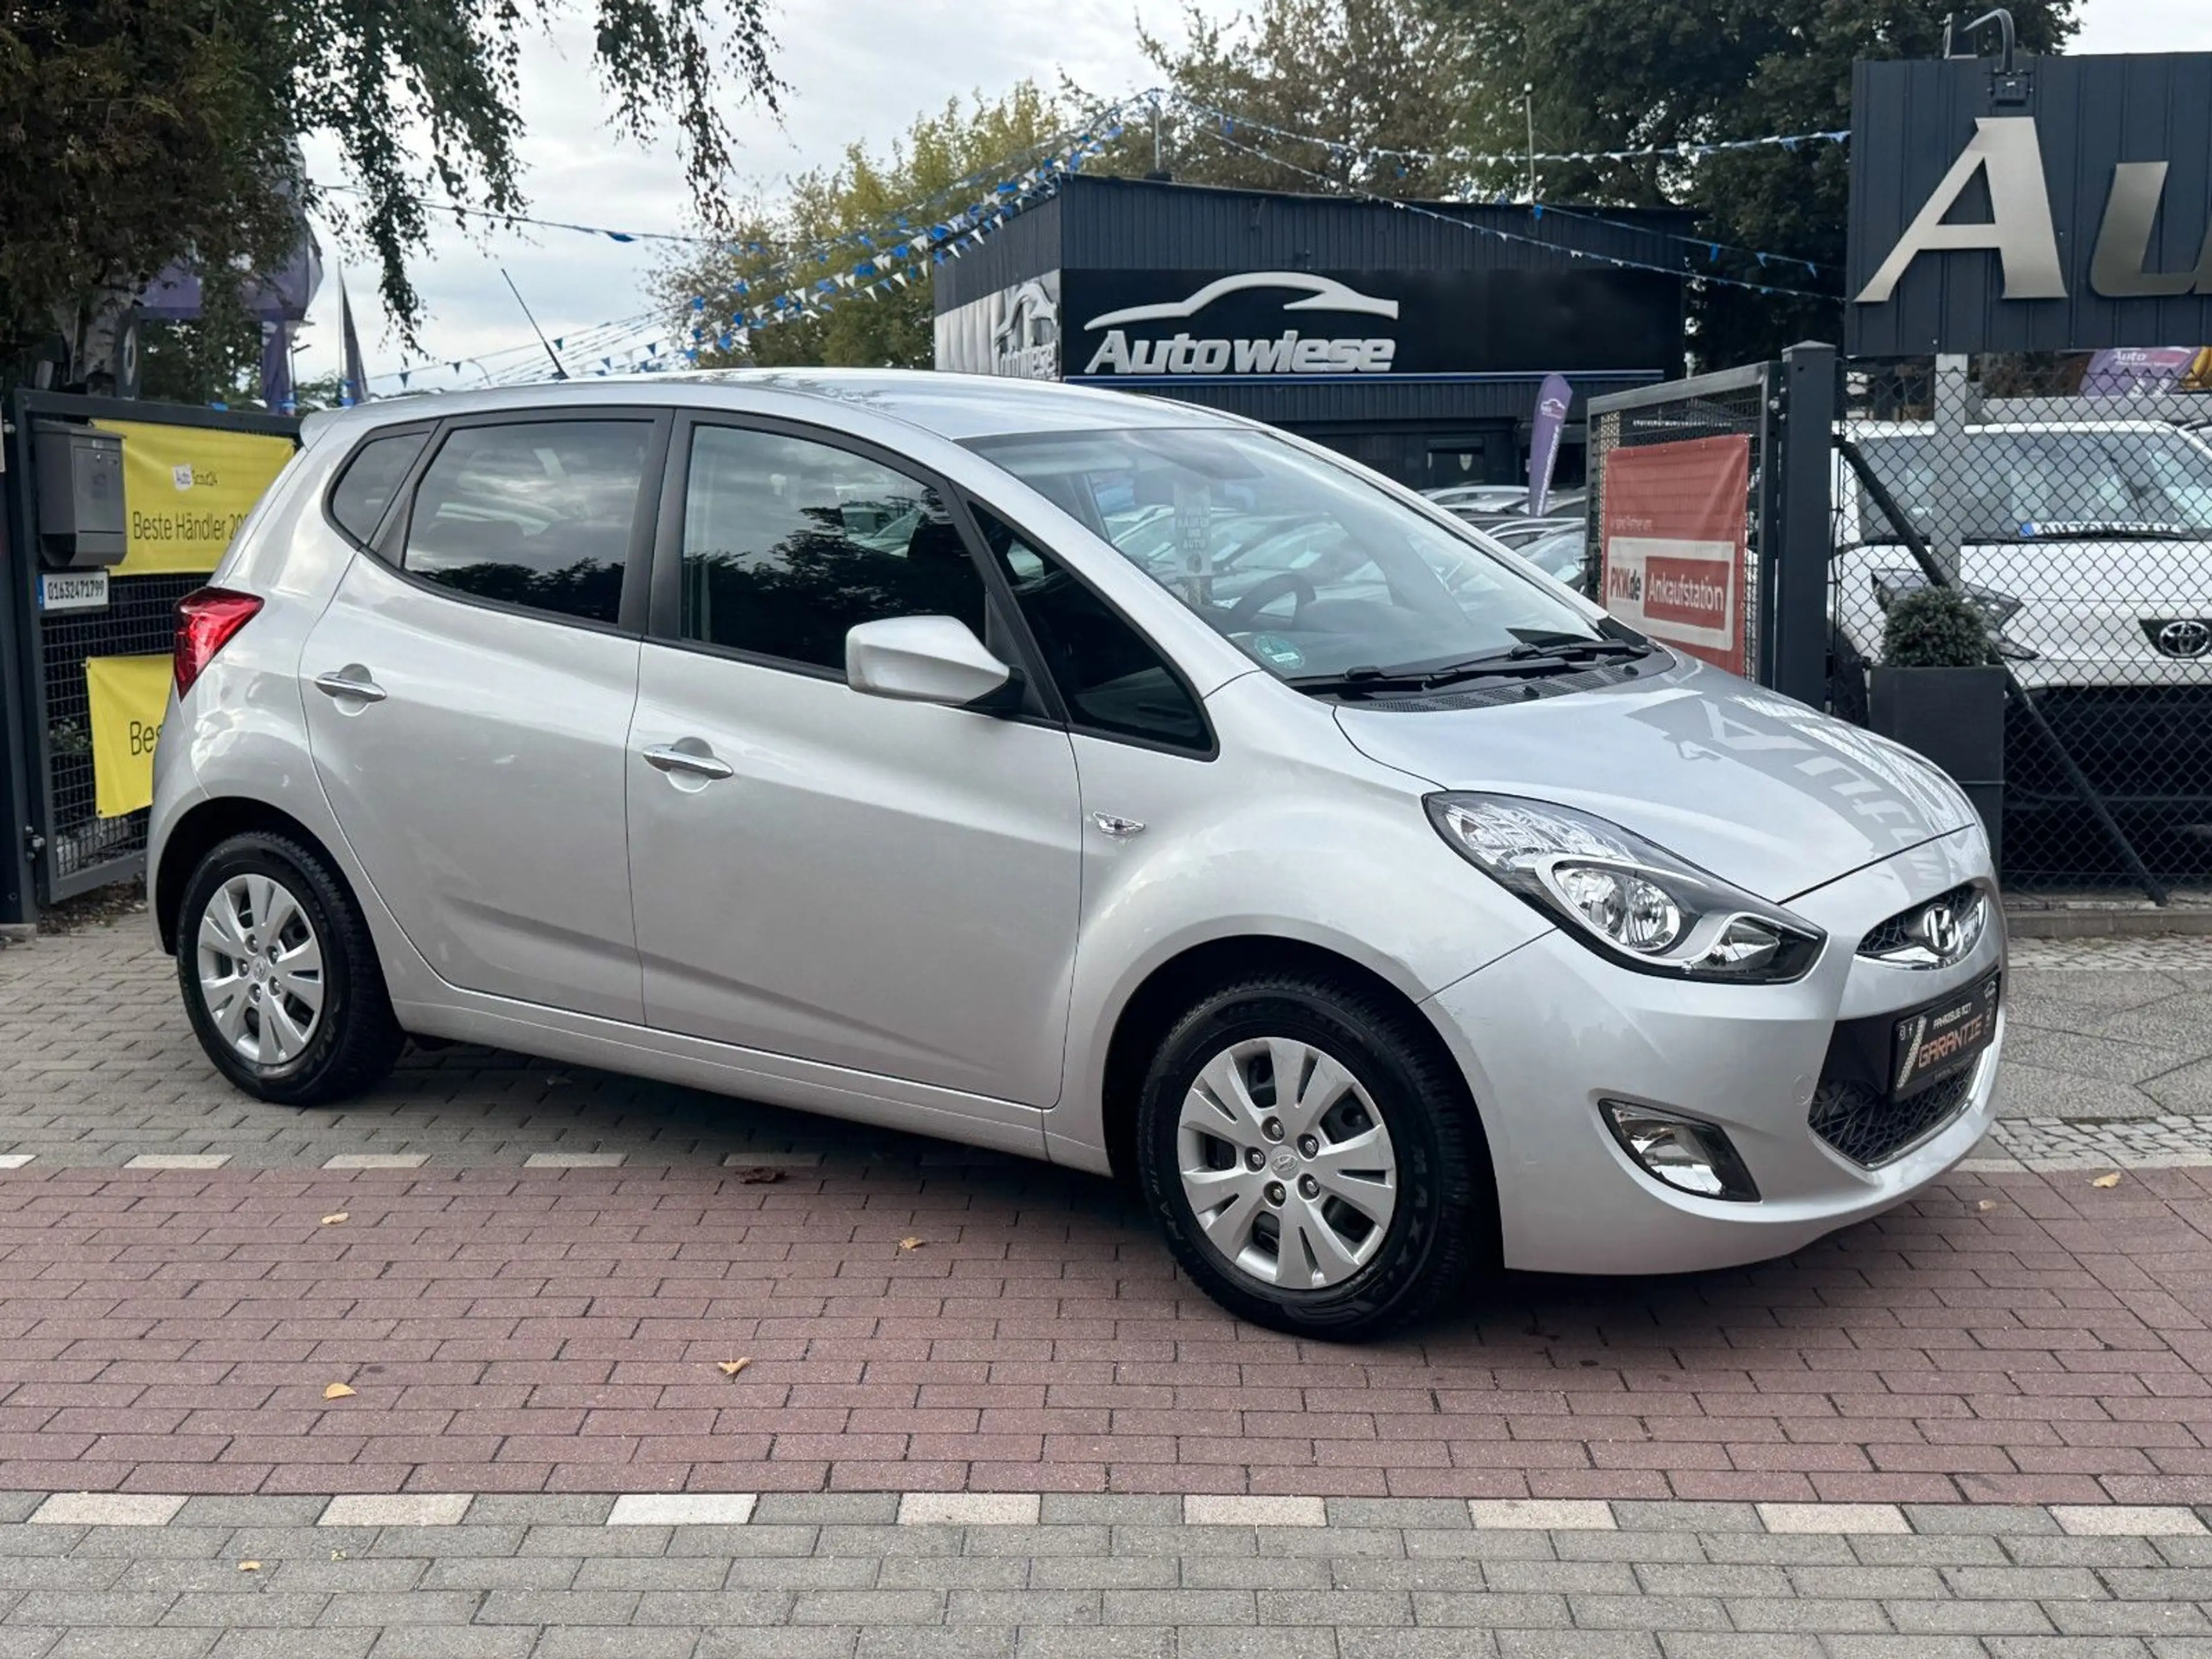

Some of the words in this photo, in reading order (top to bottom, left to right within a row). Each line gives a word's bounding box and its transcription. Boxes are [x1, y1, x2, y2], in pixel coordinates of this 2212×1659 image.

[1084, 329, 1396, 374] Autowiese
[133, 510, 172, 540] Beste
[175, 511, 226, 541] Händler
[229, 513, 248, 540] 20
[1647, 571, 1724, 611] Ankaufstation
[1918, 1013, 1982, 1069] GARANTIE
